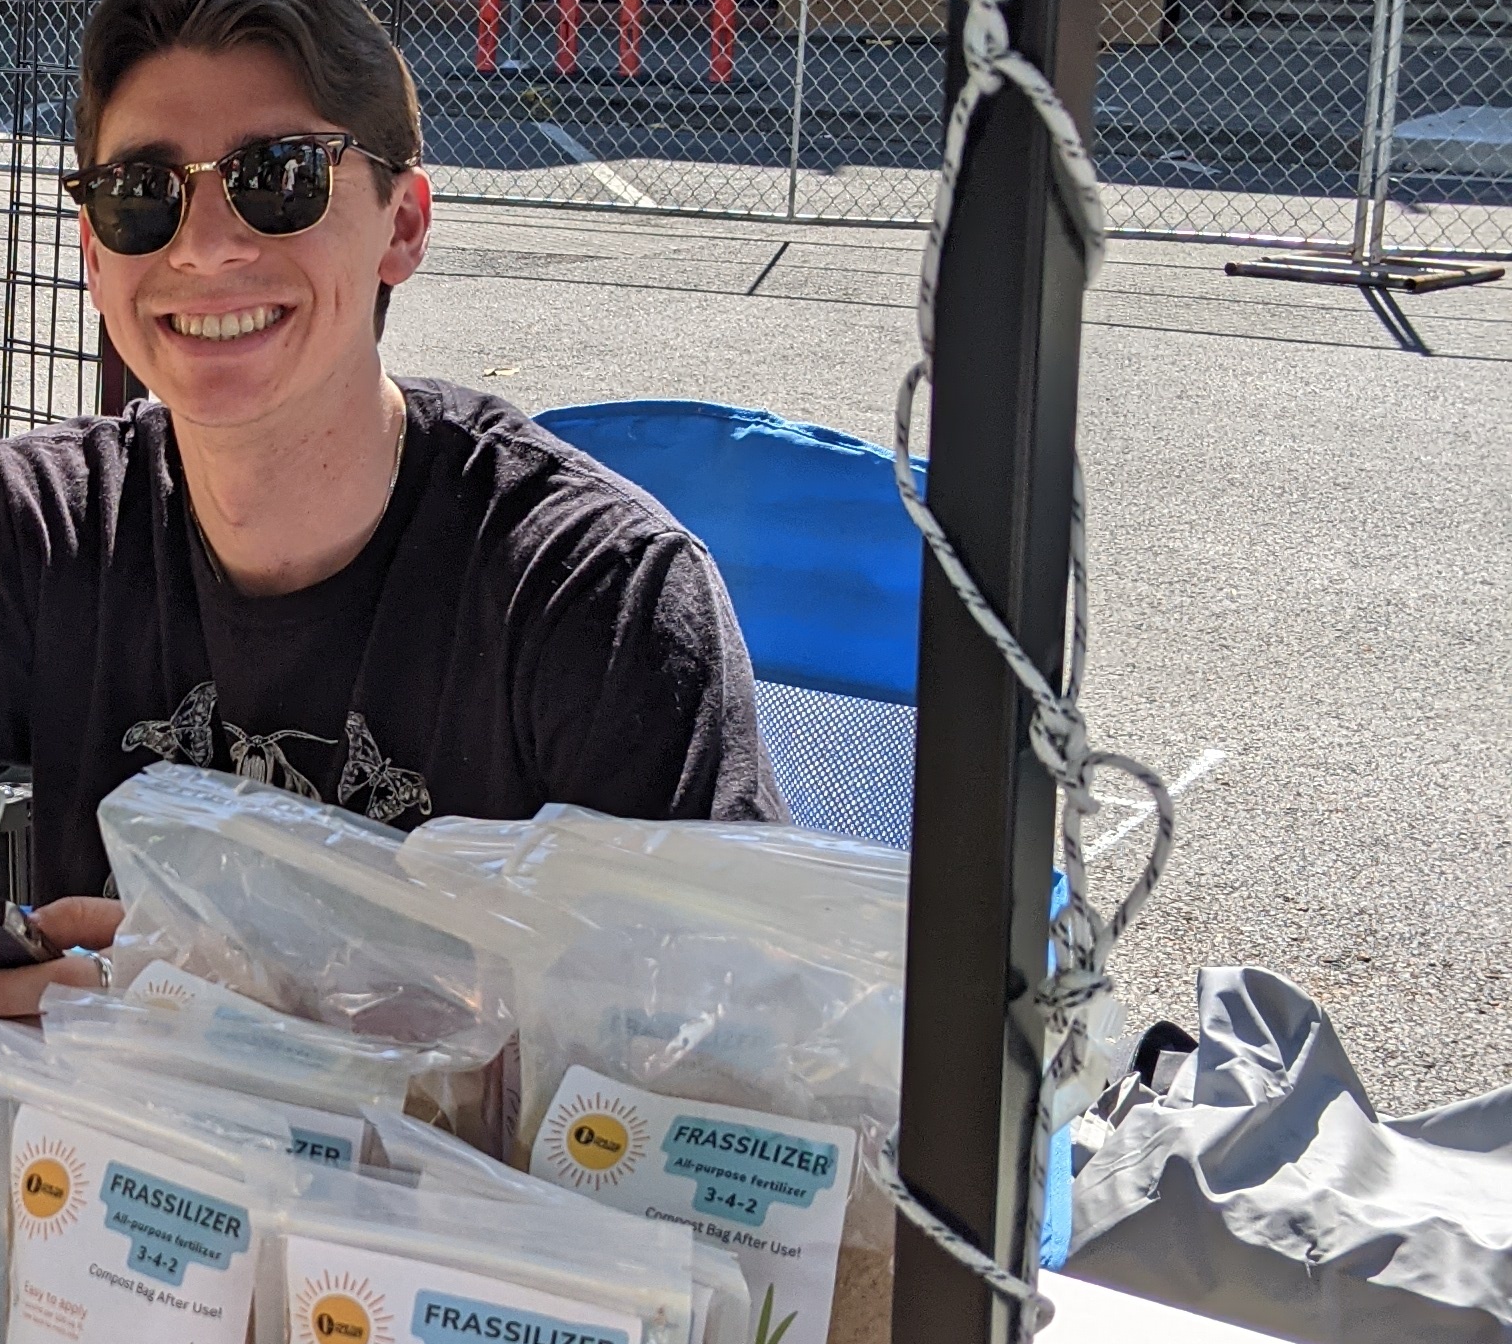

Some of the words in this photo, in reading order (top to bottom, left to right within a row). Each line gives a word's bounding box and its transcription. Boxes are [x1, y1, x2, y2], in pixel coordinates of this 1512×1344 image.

[673, 1126, 829, 1176] FRASSILIZER
[673, 1156, 747, 1184] All-purpose
[750, 1173, 808, 1198] fertilizer
[109, 1173, 242, 1239] FRASSILIZER
[704, 1187, 758, 1215] 3-4-2
[113, 1210, 173, 1243] All-purpose
[175, 1231, 222, 1260] fertilizer
[706, 1223, 731, 1244] Bag
[733, 1231, 768, 1251] After
[770, 1241, 802, 1259] Use!
[137, 1245, 179, 1274] 3-4-2
[47, 1291, 57, 1305] to
[59, 1298, 88, 1320] apply
[89, 1263, 135, 1291] Compost
[137, 1282, 155, 1301] Bag
[157, 1290, 190, 1309] After
[192, 1301, 223, 1319] Use!
